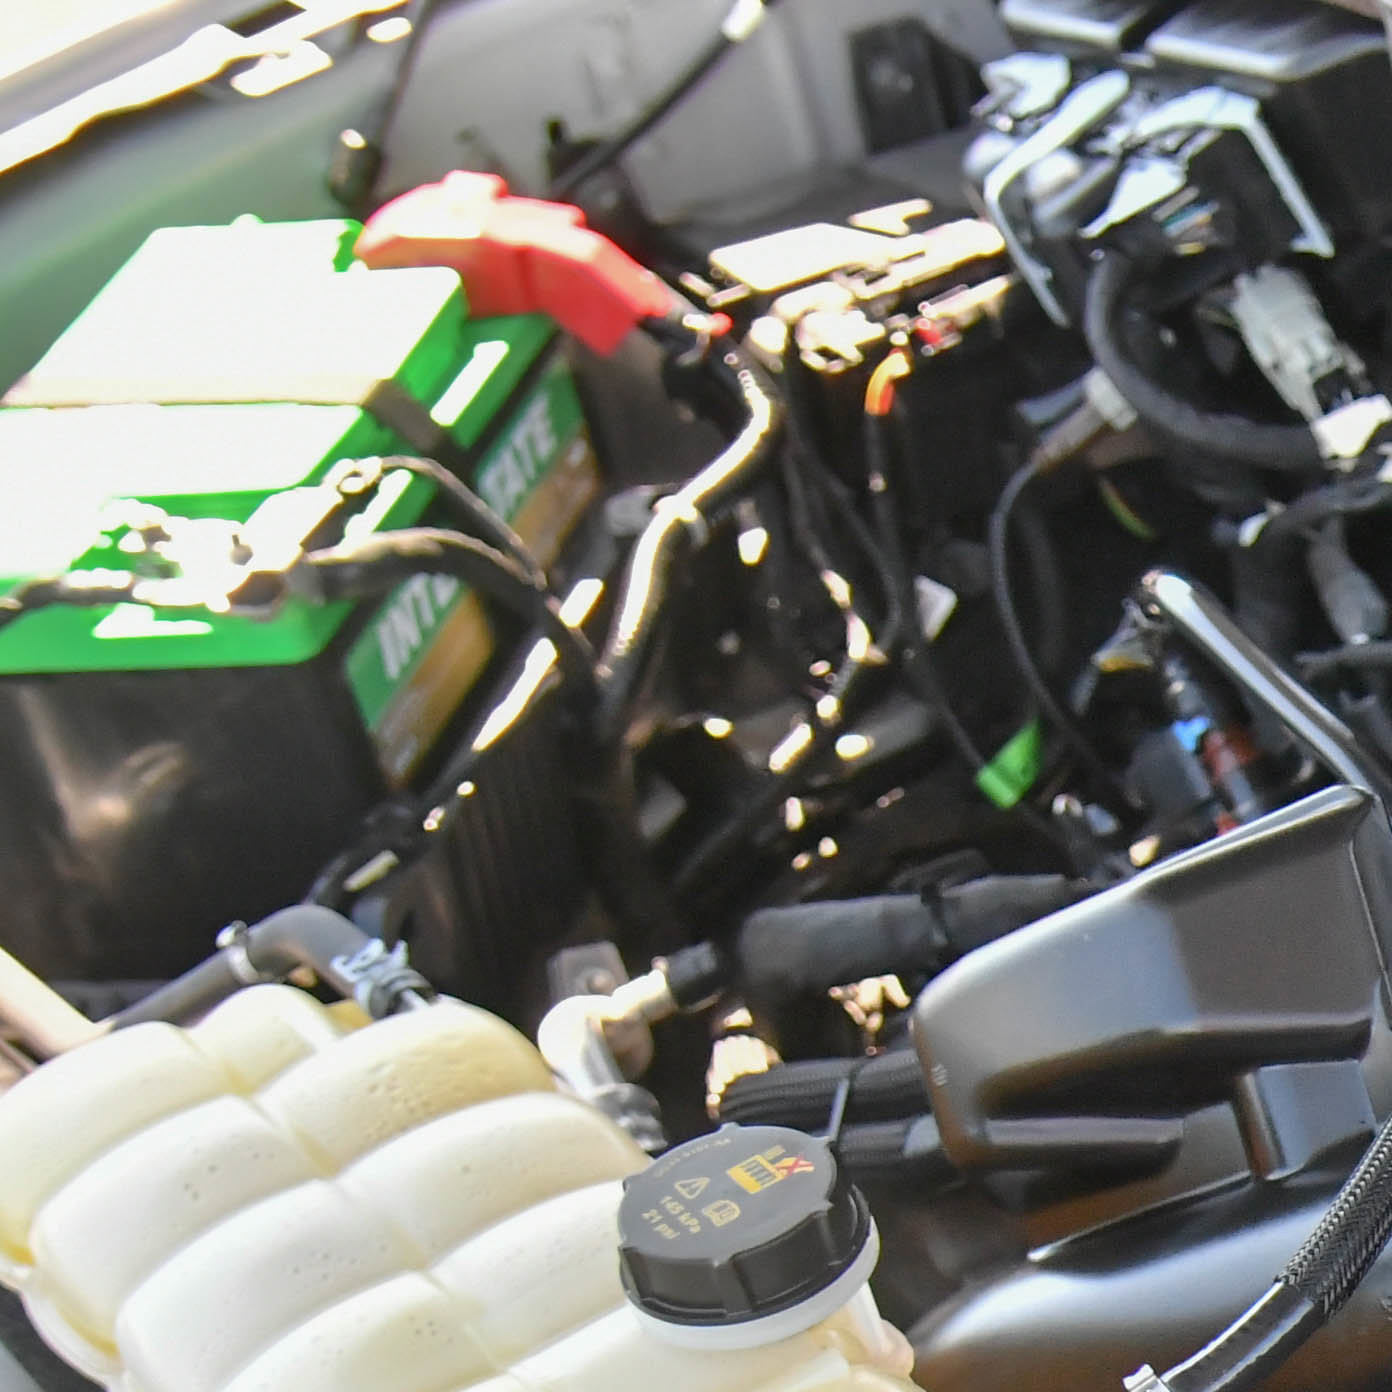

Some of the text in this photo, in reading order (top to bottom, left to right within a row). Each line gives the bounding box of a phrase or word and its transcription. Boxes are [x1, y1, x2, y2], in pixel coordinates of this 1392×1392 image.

[641, 1208, 664, 1224] 21
[659, 1195, 702, 1235] 145 kPa
